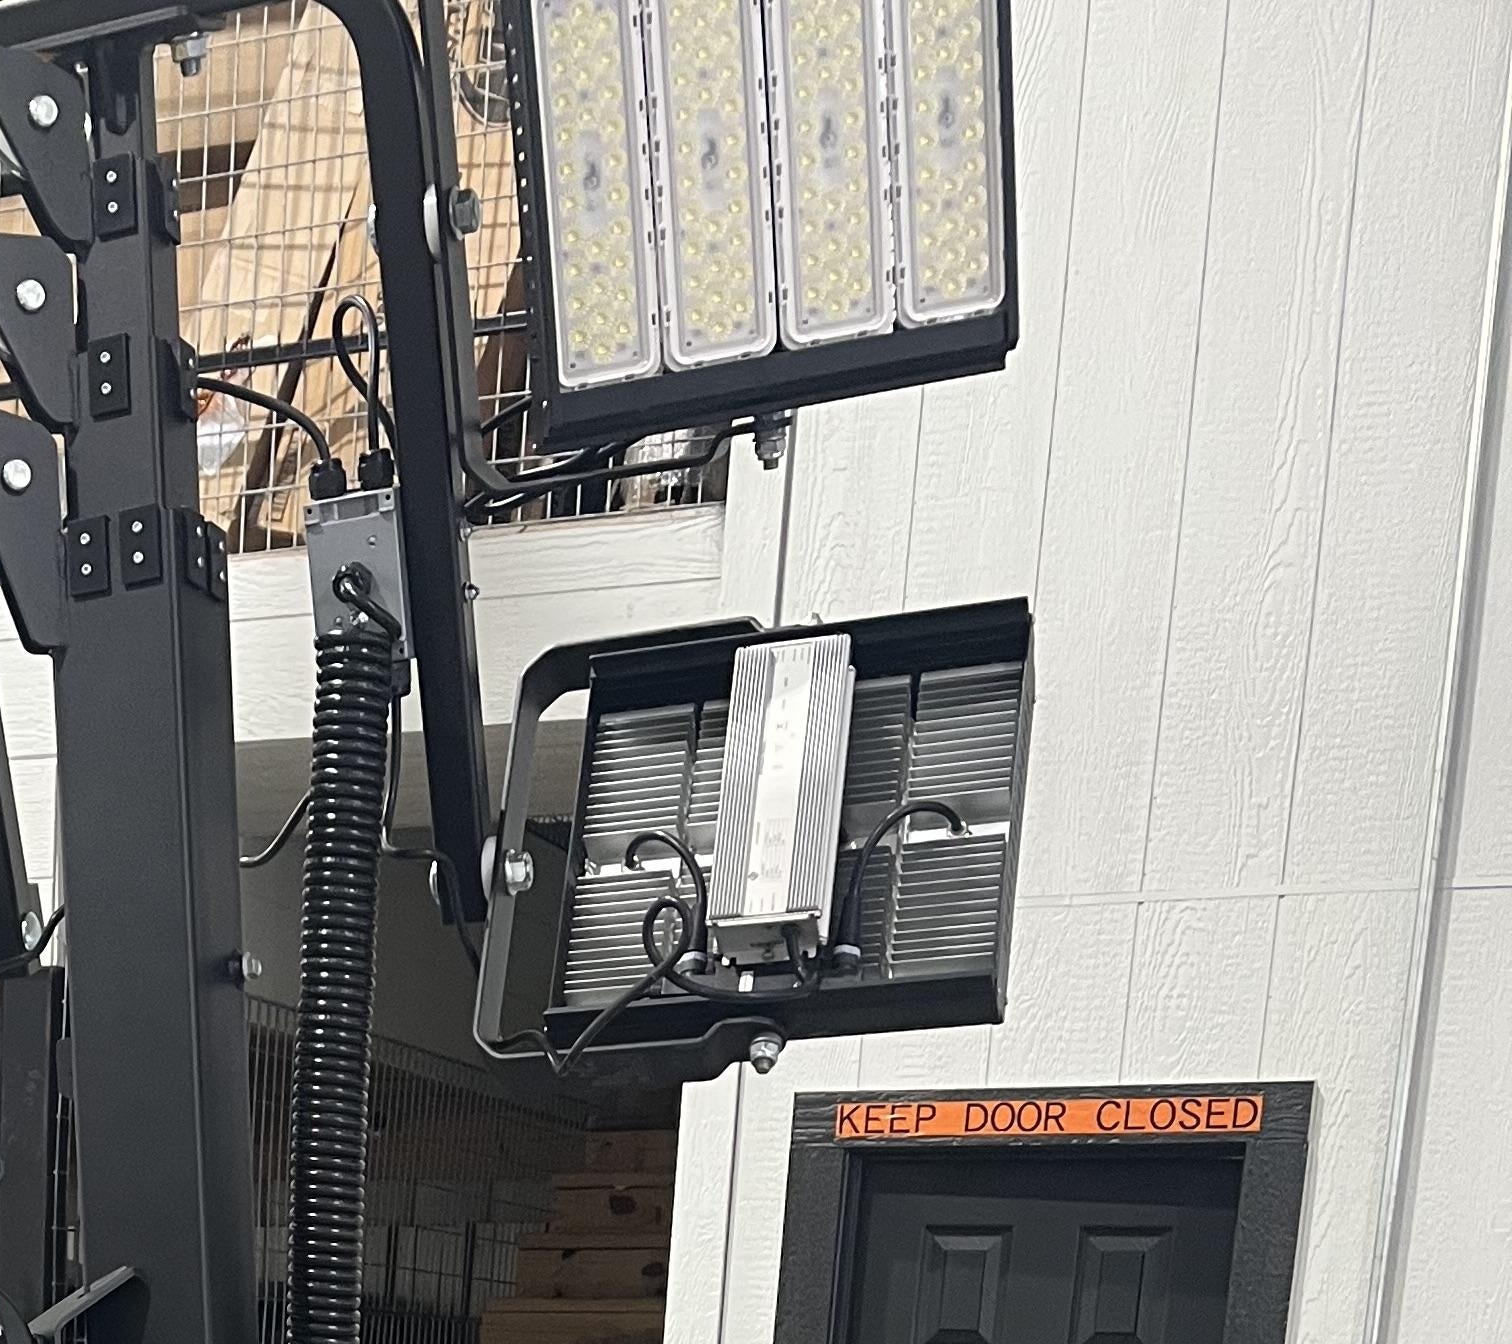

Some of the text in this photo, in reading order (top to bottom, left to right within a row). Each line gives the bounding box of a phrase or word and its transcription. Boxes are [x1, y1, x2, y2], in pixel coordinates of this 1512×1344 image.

[838, 1098, 1258, 1134] KEEP DOOR CLOSED
